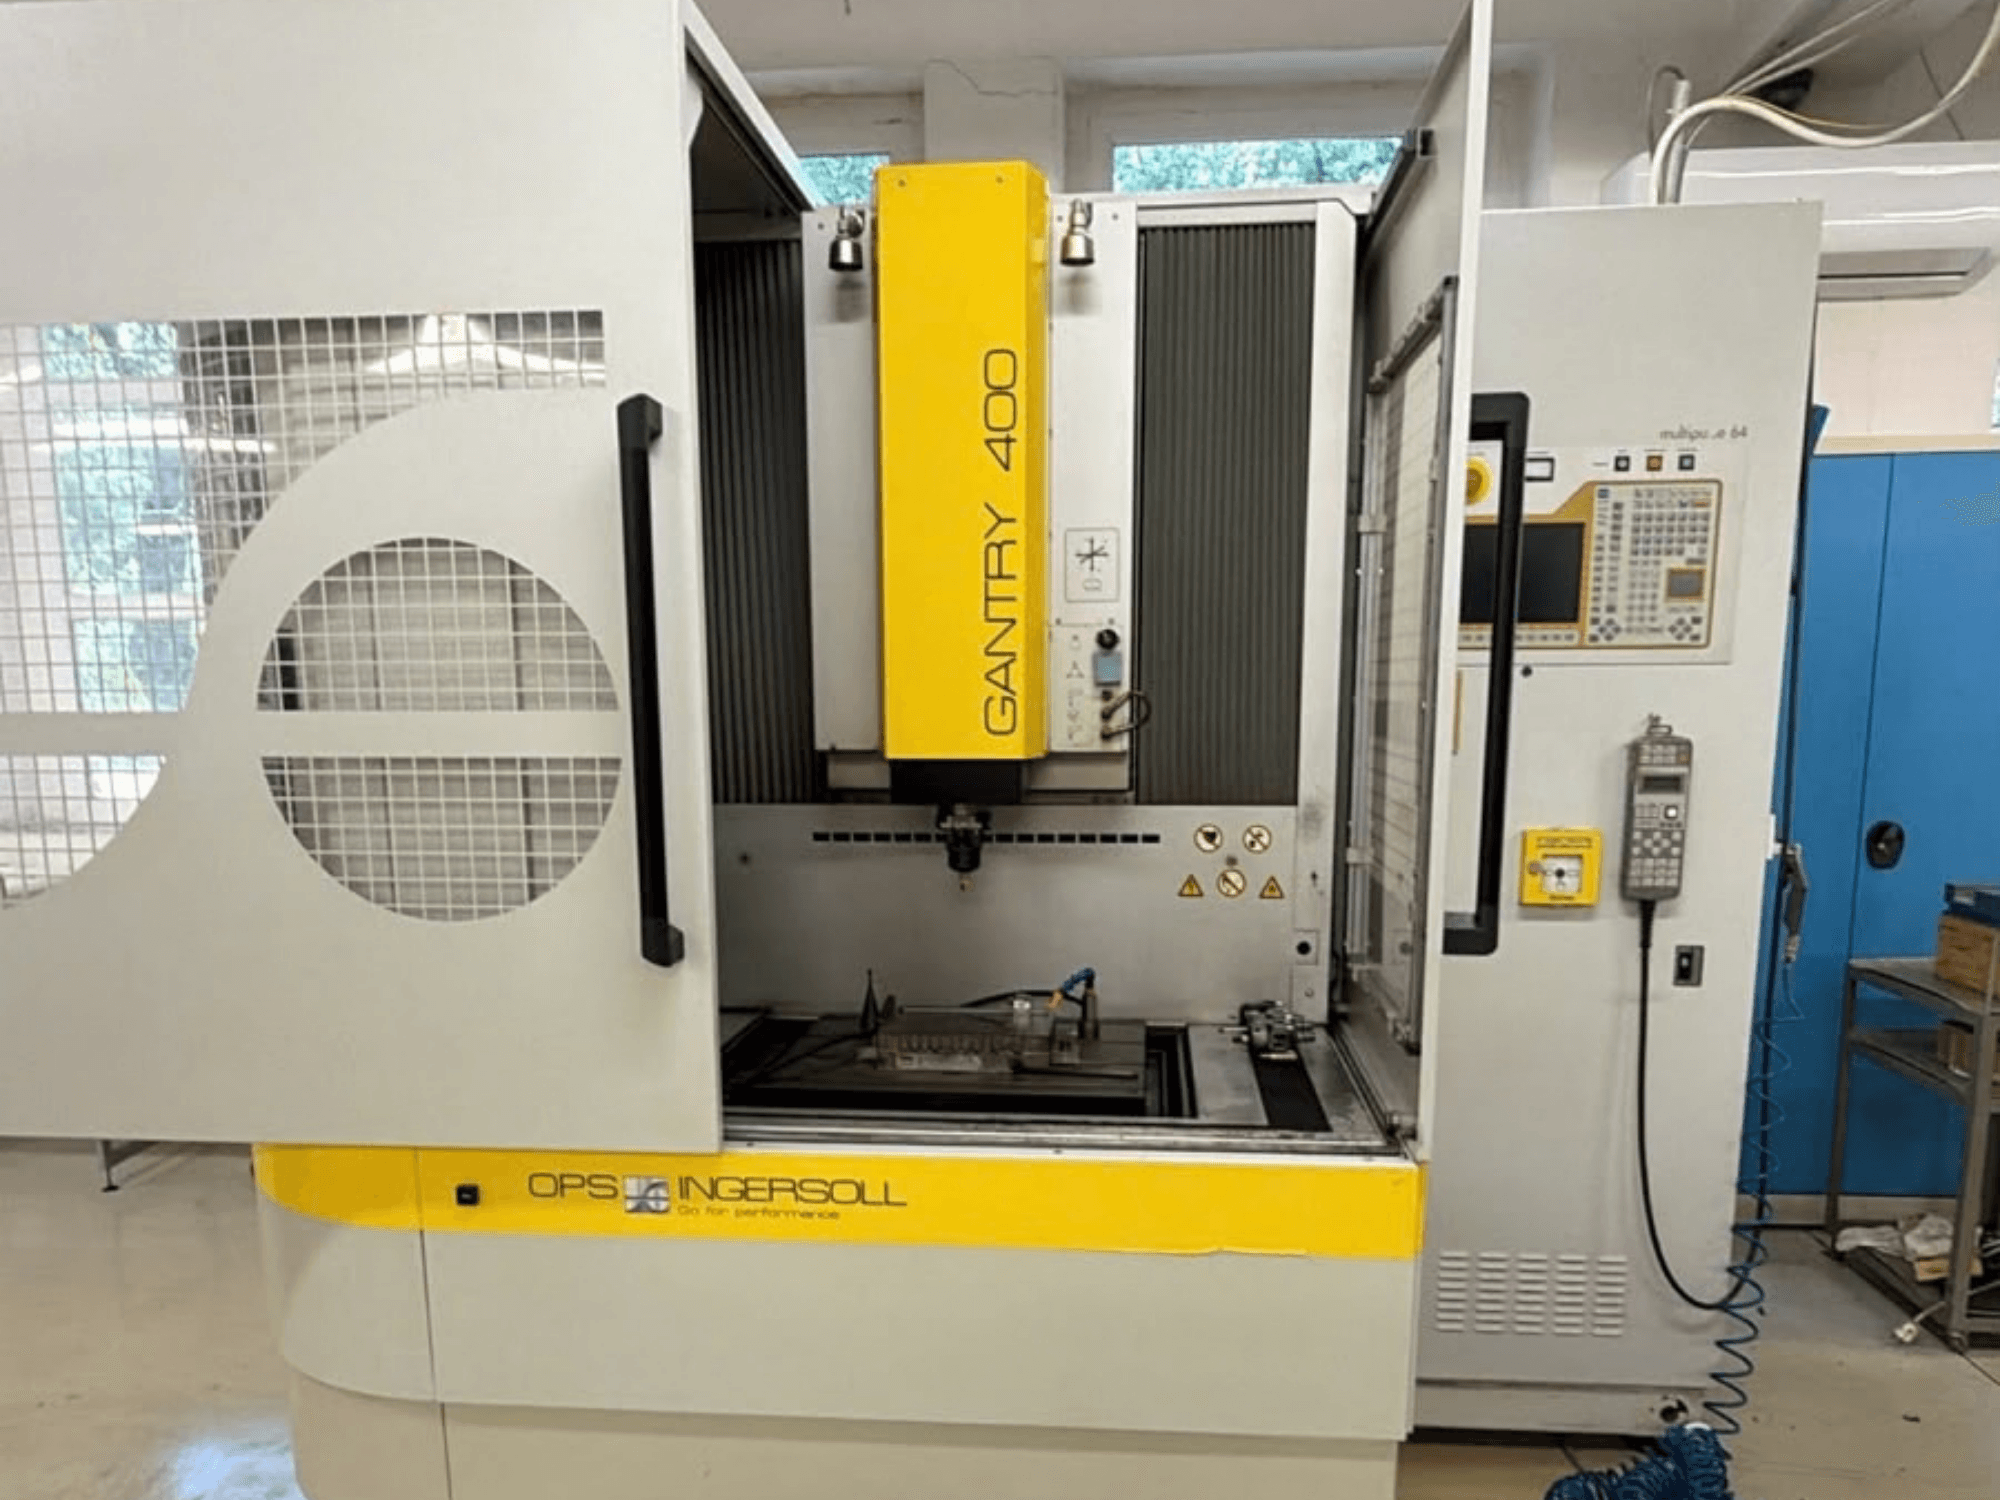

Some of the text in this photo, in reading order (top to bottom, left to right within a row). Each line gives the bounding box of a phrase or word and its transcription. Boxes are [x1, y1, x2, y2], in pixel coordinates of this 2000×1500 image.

[1659, 424, 1748, 443] multipue 64
[983, 348, 1018, 736] GANTRY 400
[527, 1172, 908, 1207] OPS INGERSOLL
[705, 1205, 729, 1218] for
[734, 1206, 840, 1220] performance
